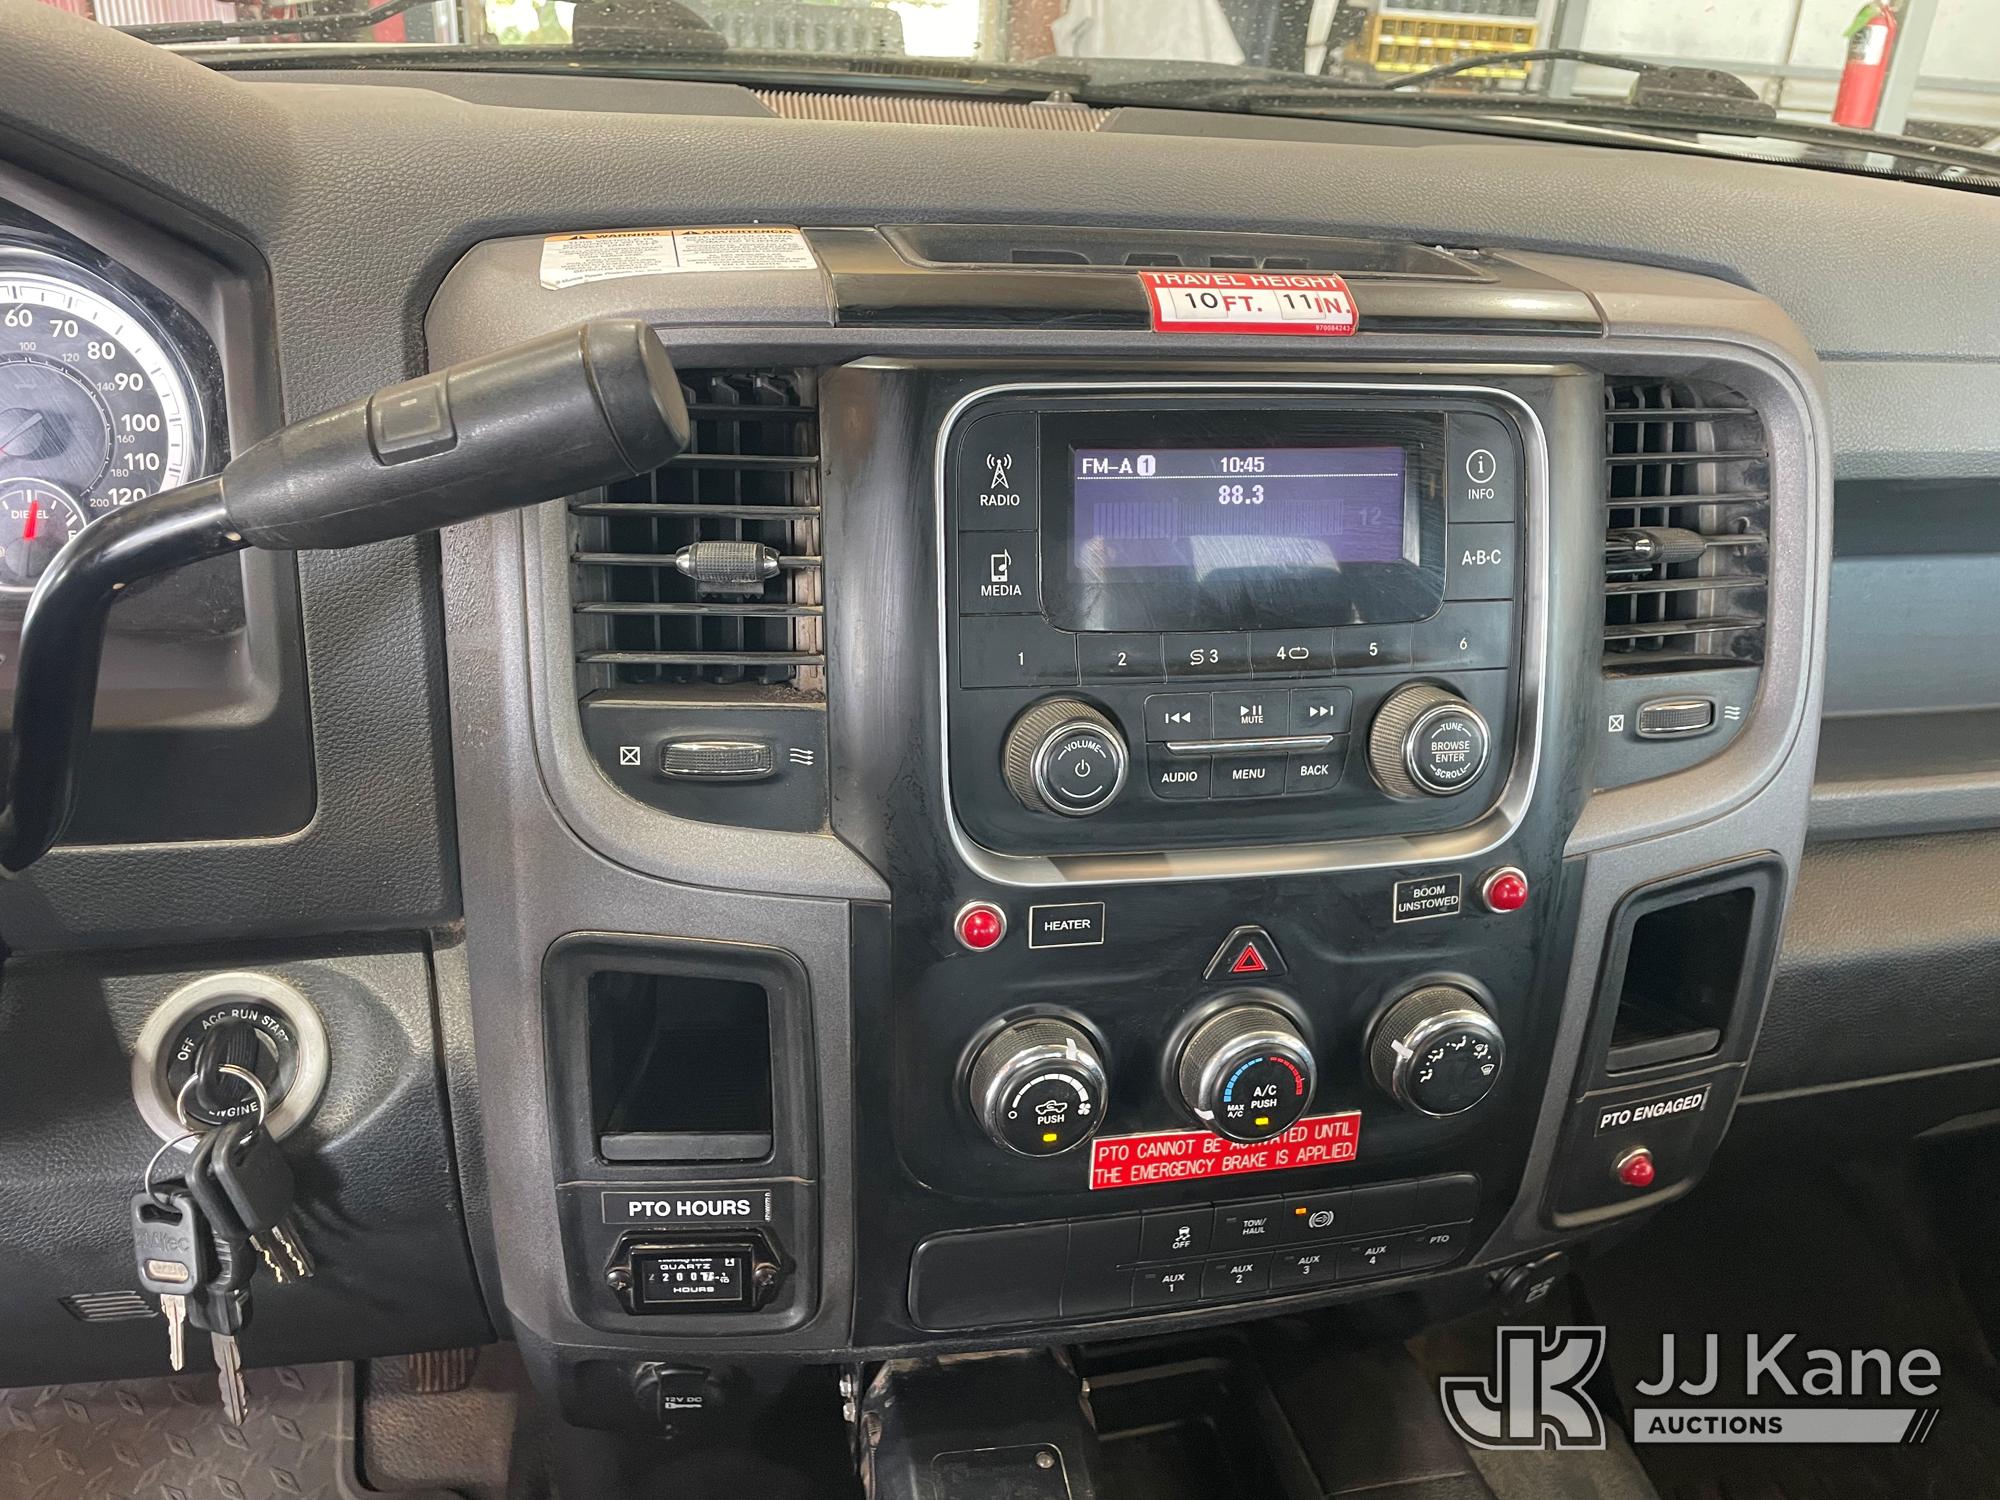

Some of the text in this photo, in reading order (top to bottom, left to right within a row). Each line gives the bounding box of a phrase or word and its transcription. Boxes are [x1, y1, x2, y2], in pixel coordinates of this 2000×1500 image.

[1148, 273, 1339, 289] TRAVEL HEIGHT
[1185, 292, 1351, 314] 10 FT. 11 IN.
[5, 310, 33, 328] 60
[50, 319, 78, 338] 70
[19, 342, 37, 351] 100
[87, 342, 115, 360] 80
[62, 353, 80, 362] 120
[97, 382, 115, 391] 140
[114, 373, 143, 391] 90
[121, 414, 160, 432] 100
[117, 435, 135, 444] 160
[124, 453, 160, 471] 110
[1082, 457, 1133, 474] FM-A
[1220, 456, 1265, 472] 10:45
[111, 468, 129, 478] 180
[108, 488, 147, 505] 120
[1218, 485, 1265, 504] 88.3
[1467, 487, 1495, 500] INFO
[90, 498, 110, 508] 200
[979, 493, 1020, 507] RADIO
[11, 510, 49, 519] DIEEL
[980, 584, 1022, 597] MEDIA
[1369, 642, 1378, 656] 5
[1459, 637, 1468, 650] 6
[1018, 652, 1025, 665] 1
[1118, 652, 1127, 666] 2
[1209, 649, 1219, 663] 3
[1276, 646, 1286, 660] 4
[1241, 715, 1263, 724] MUTE
[1440, 722, 1464, 731] TUNE
[1064, 740, 1101, 753] VOLUME
[1431, 740, 1470, 751] BROWSE
[1435, 753, 1465, 763] ENTER
[1232, 768, 1265, 780] MENU
[1300, 764, 1329, 776] BACK
[1435, 767, 1467, 779] SCROLL
[1161, 771, 1198, 783] AUDIO
[1413, 885, 1446, 898] BOOM
[1398, 895, 1459, 912] UNSTOWED
[1044, 919, 1091, 931] HEATER
[177, 1009, 290, 1061] OFF ACC RUN START
[1253, 1084, 1277, 1097] A/C
[1251, 1099, 1277, 1109] PUSH
[1227, 1111, 1244, 1119] A/C
[1600, 1093, 1702, 1129] PTO ENGAGED
[1037, 1113, 1065, 1125] PUSH
[1099, 1145, 1129, 1162] PTO
[1137, 1138, 1195, 1158] CANNOT
[1203, 1136, 1223, 1153] BE
[1315, 1122, 1354, 1140] UNTIL
[1095, 1141, 1355, 1184] THE EMERGENCY BRAKE IS APPLIED.
[628, 1201, 671, 1217] PTO
[676, 1199, 751, 1216] HOURS
[1243, 1217, 1267, 1228] TOW/
[1242, 1226, 1266, 1235] HAUL
[1172, 1240, 1190, 1249] OFF
[1429, 1234, 1450, 1244] PTO
[1365, 1245, 1387, 1256] AUX
[1297, 1254, 1320, 1265] AUX
[1368, 1256, 1377, 1265] 4
[1230, 1264, 1253, 1274] AUX
[1303, 1265, 1311, 1274] 3
[1162, 1273, 1185, 1283] AUX
[1235, 1274, 1243, 1284] 2
[1169, 1284, 1175, 1292] 1
